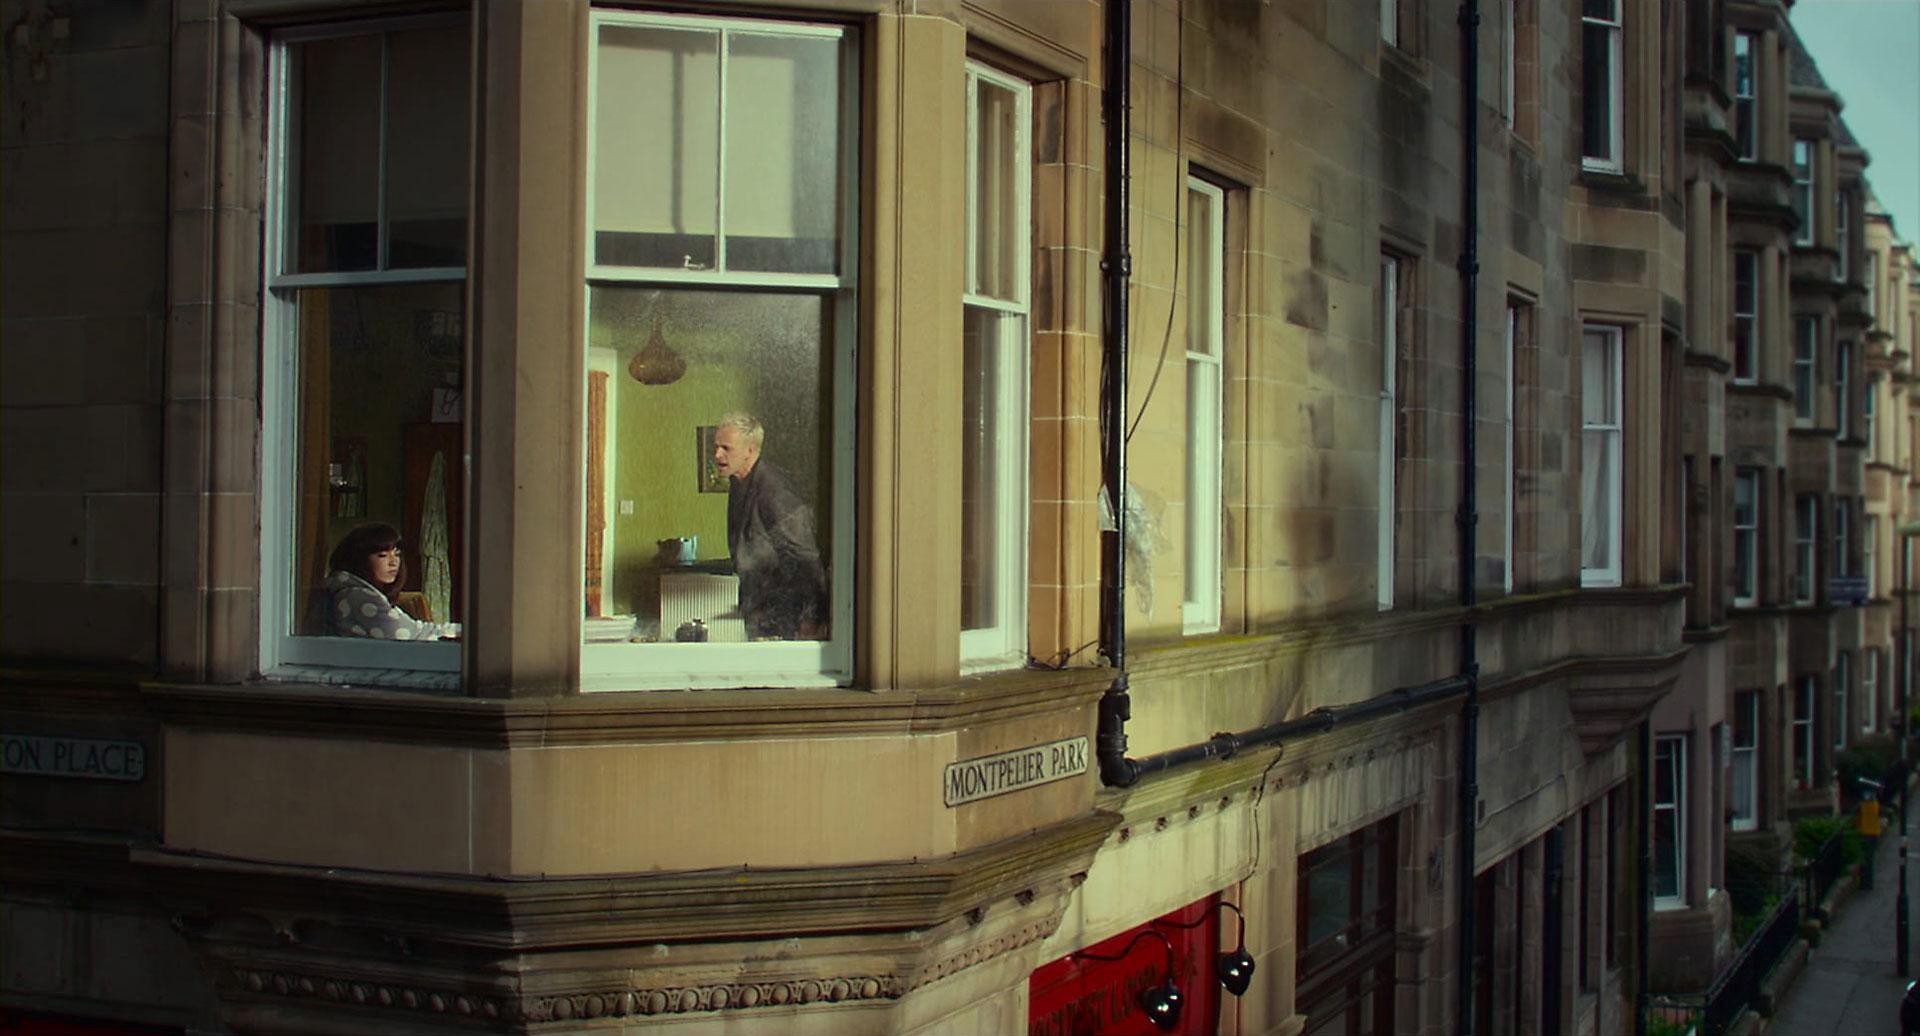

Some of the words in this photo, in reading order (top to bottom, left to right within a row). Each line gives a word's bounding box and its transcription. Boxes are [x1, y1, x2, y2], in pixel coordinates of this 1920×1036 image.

[0, 738, 41, 770] ON
[53, 741, 139, 775] PLACE
[950, 751, 1045, 800] MONTPELIER
[1051, 740, 1086, 776] PARK
